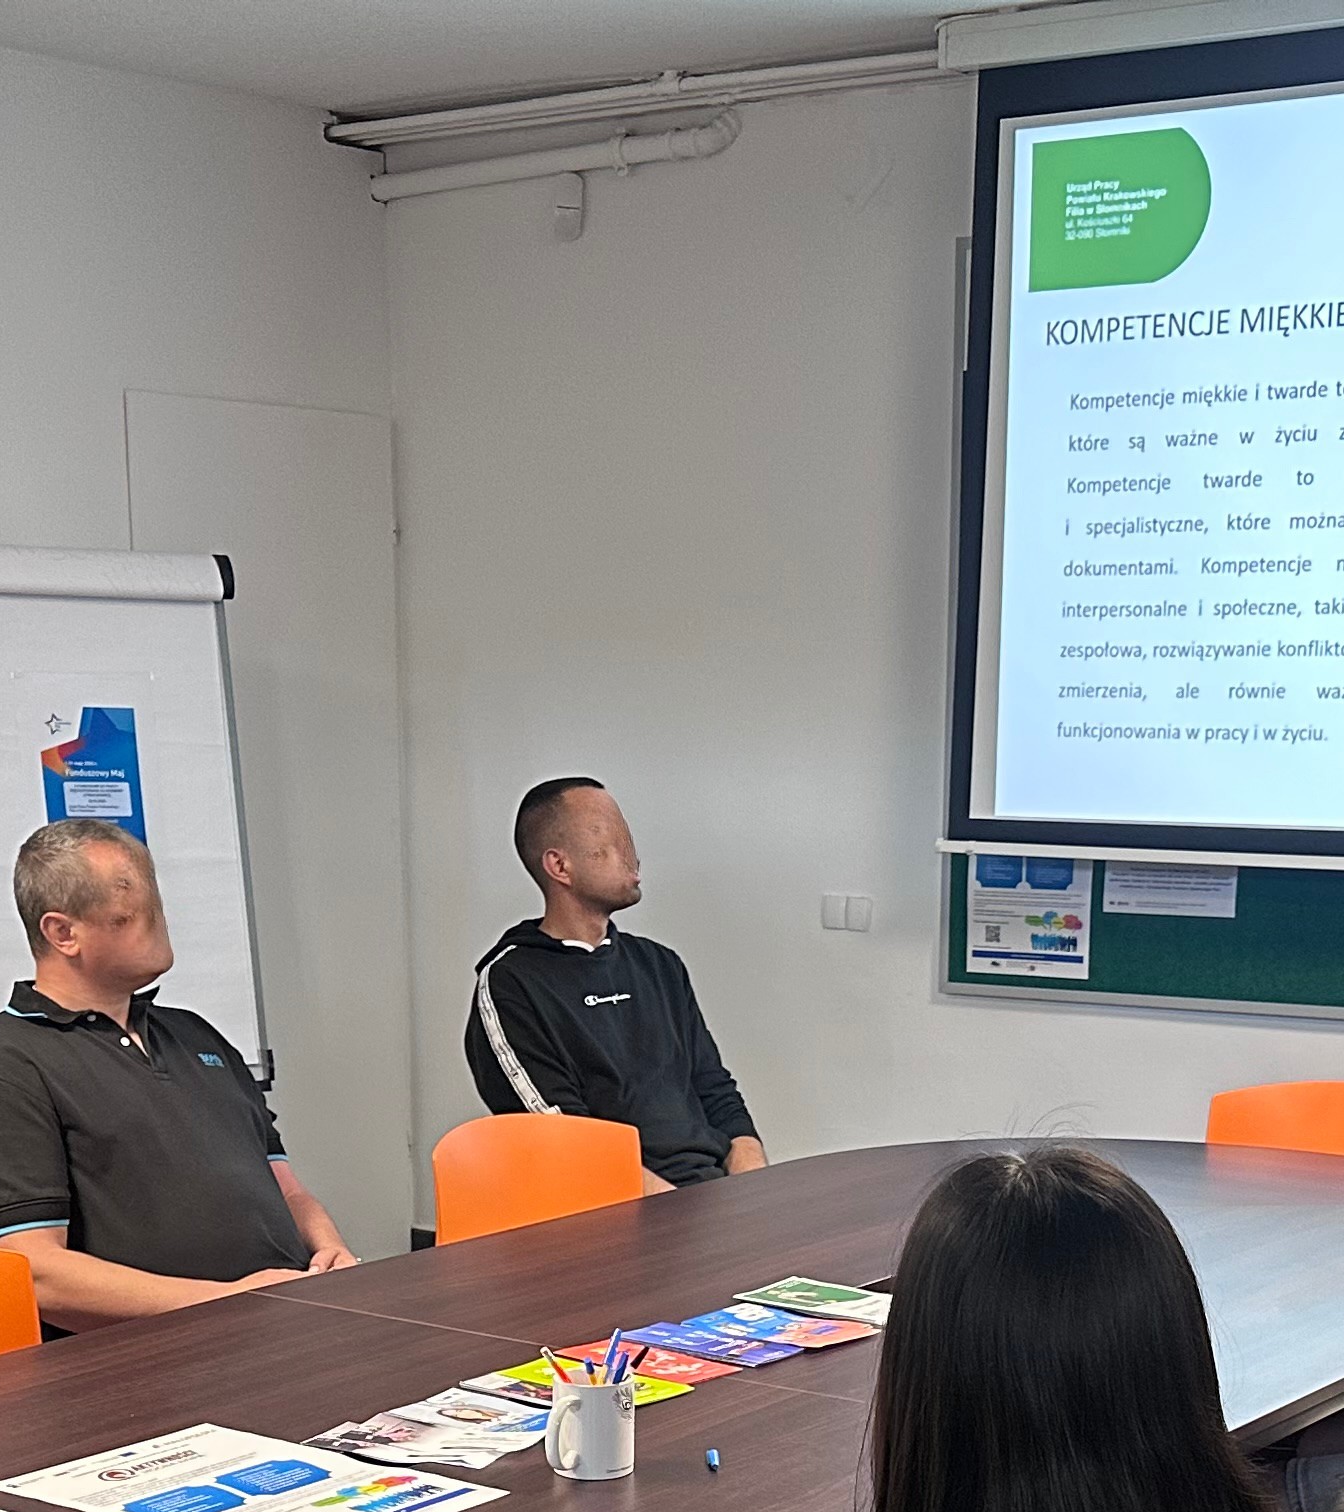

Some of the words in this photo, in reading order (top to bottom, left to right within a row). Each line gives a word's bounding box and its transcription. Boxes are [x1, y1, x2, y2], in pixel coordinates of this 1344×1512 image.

[1094, 180, 1120, 191] Pracy
[1046, 308, 1232, 347] KOMPETENCJE
[1069, 388, 1176, 414] Kompetencje
[1181, 383, 1249, 408] miękkie
[1254, 382, 1261, 402] i
[1266, 379, 1329, 401] twarde
[1068, 433, 1110, 453] które
[1128, 435, 1146, 454] są
[1164, 429, 1219, 448] ważne
[1238, 430, 1255, 445] w
[1274, 423, 1318, 448] życiu
[1066, 473, 1172, 497] Kompetencje
[1202, 469, 1263, 490] twarde
[1296, 469, 1315, 487] to
[1064, 518, 1070, 537] i
[1085, 516, 1209, 539] specjalistyczne,
[1226, 511, 1272, 532] które
[1063, 557, 1179, 578] dokumentami.
[1200, 554, 1313, 578] Kompetencje
[1061, 599, 1188, 622] interpersonalne
[1197, 598, 1203, 617] i
[1212, 598, 1302, 620] społeczne,
[1059, 640, 1148, 662] zespołowa,
[1152, 639, 1272, 662] rozwiązywanie
[1057, 681, 1148, 702] zmierzenia,
[1175, 681, 1200, 700] ale
[1228, 681, 1287, 700] równie
[1056, 721, 1181, 743] funkcjonowania
[1185, 727, 1201, 740] w
[1204, 727, 1250, 745] pracy
[1253, 724, 1259, 741] i
[1262, 727, 1278, 741] w
[1281, 724, 1329, 746] życiu.
